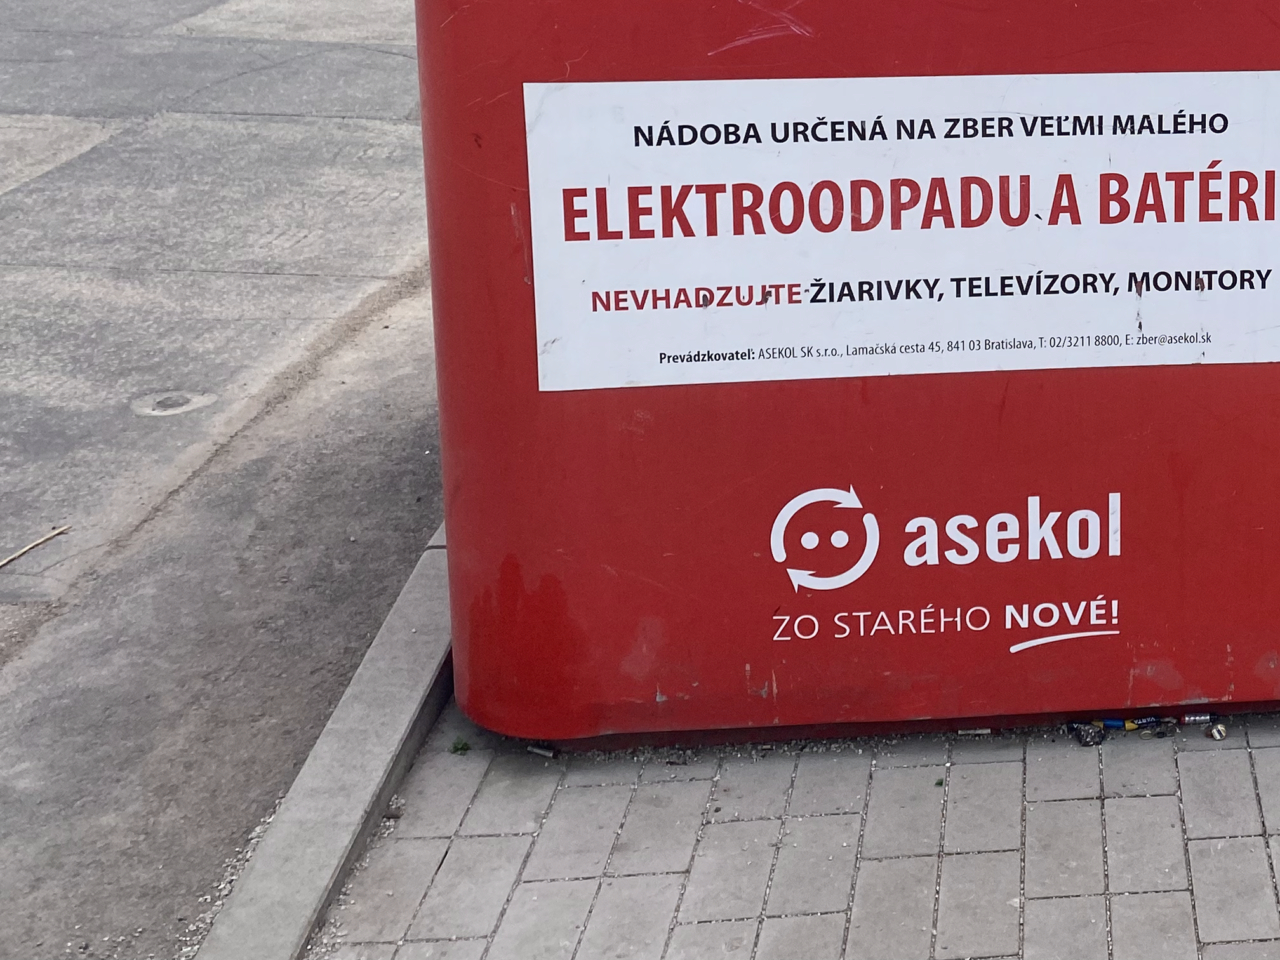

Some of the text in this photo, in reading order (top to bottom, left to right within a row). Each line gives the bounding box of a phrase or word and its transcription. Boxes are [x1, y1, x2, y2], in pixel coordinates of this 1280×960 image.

[633, 110, 1229, 147] NÁDOBA URČENÁ NA ZBER VEĽMI MALÉHO
[562, 174, 1031, 241] ELEKTROODPADU
[1047, 173, 1082, 226] A
[591, 269, 1273, 312] NEVHADZUJTE ŽIARIVKY, TELEVÍZORY, MONITORY
[659, 332, 1212, 364] Prevádzkovateľ: ASEKOL SK s.r.o., Lamačská cesta 45, 841 03 Bratislava, T: 02/3211 8800, E: zber@asekol.sk
[903, 492, 1121, 567] asekol
[772, 594, 1120, 641] ZO STARÉHO NOVÉ!
